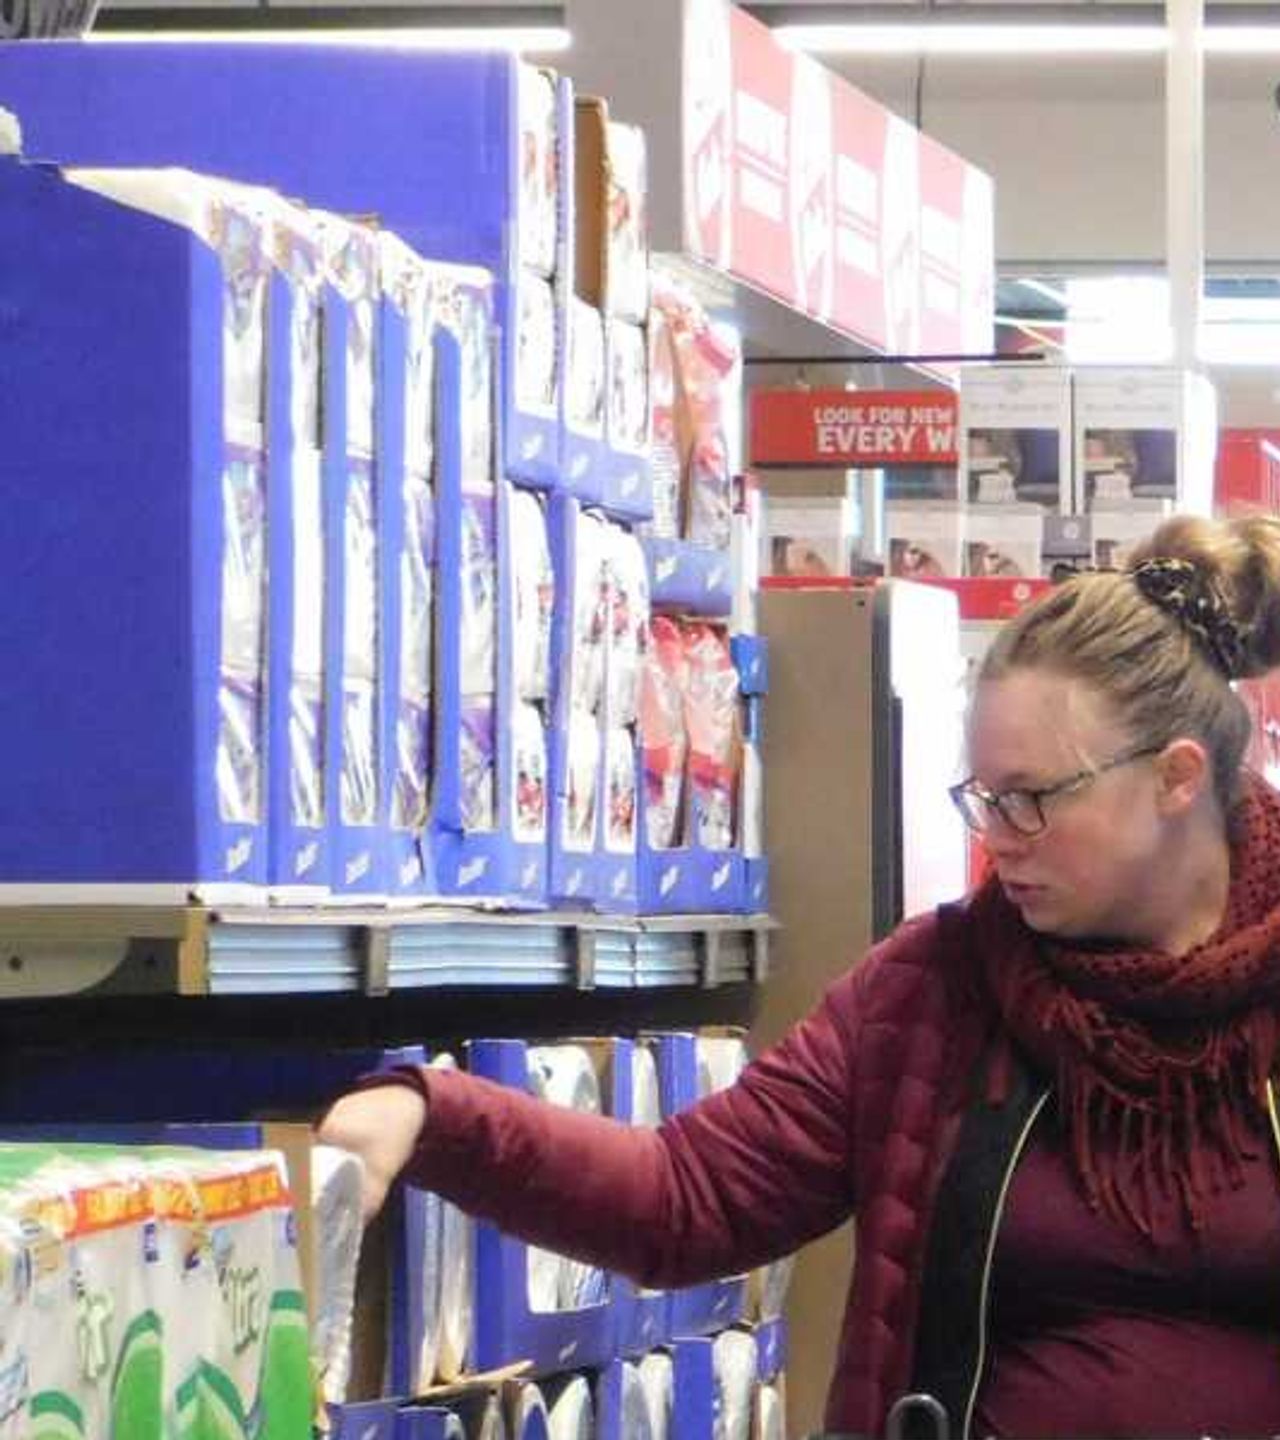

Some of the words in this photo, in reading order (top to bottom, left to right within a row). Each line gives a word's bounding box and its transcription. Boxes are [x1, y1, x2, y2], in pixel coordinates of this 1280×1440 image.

[814, 405, 866, 424] LOOK
[869, 405, 908, 424] FOR
[911, 405, 955, 424] NEW
[817, 424, 916, 453] EVERY
